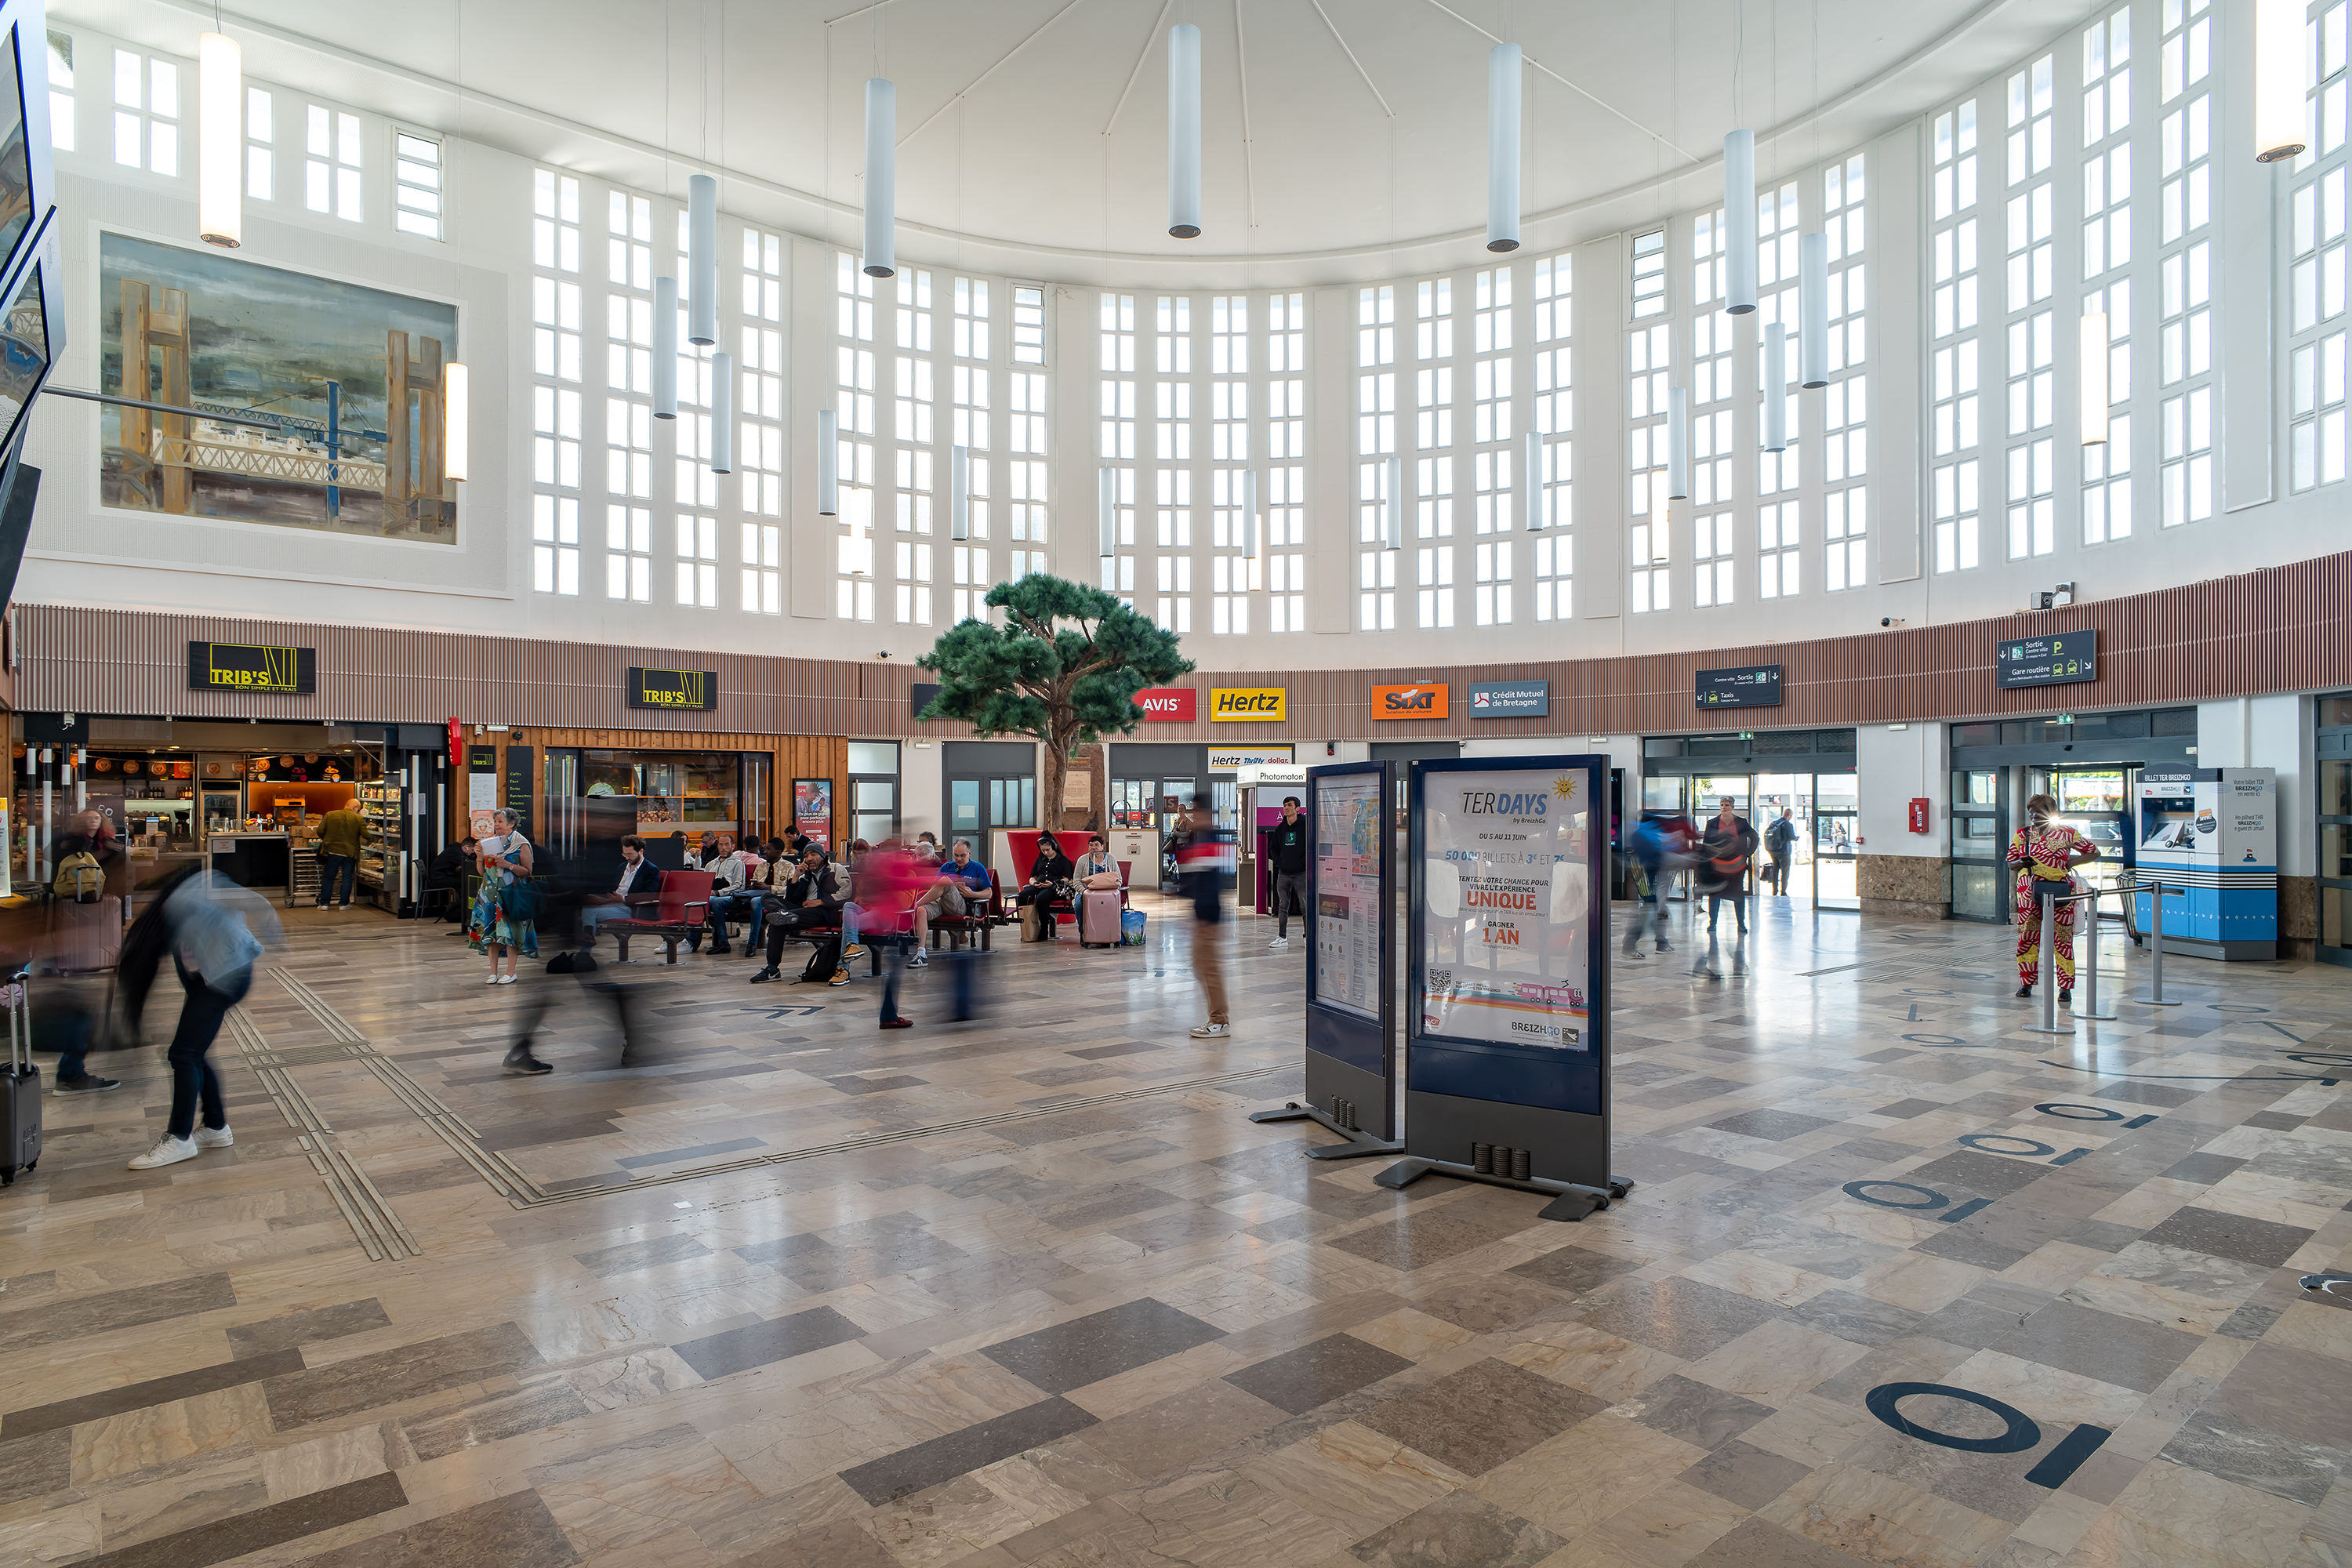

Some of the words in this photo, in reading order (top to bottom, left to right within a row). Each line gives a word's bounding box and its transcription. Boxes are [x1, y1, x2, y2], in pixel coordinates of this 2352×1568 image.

[212, 669, 269, 684] TRIB'S
[644, 690, 684, 702] TRIB'S
[1218, 693, 1279, 710] Hertz
[1493, 691, 1515, 699] Crédit
[1143, 699, 1178, 711] AVIS
[1211, 756, 1240, 765] Hertz
[1446, 851, 1459, 860] 50
[1483, 852, 1515, 864] BILLETS
[1518, 851, 1524, 863] À
[1526, 854, 1537, 864] 3€
[1541, 855, 1551, 865] ET
[1490, 884, 1535, 893] L'EXPÉRIENCE
[1468, 891, 1537, 910] UNIQUE
[1483, 928, 1490, 942] 1
[1494, 929, 1519, 945] AN
[1512, 1022, 1560, 1036] BREIZHGO
